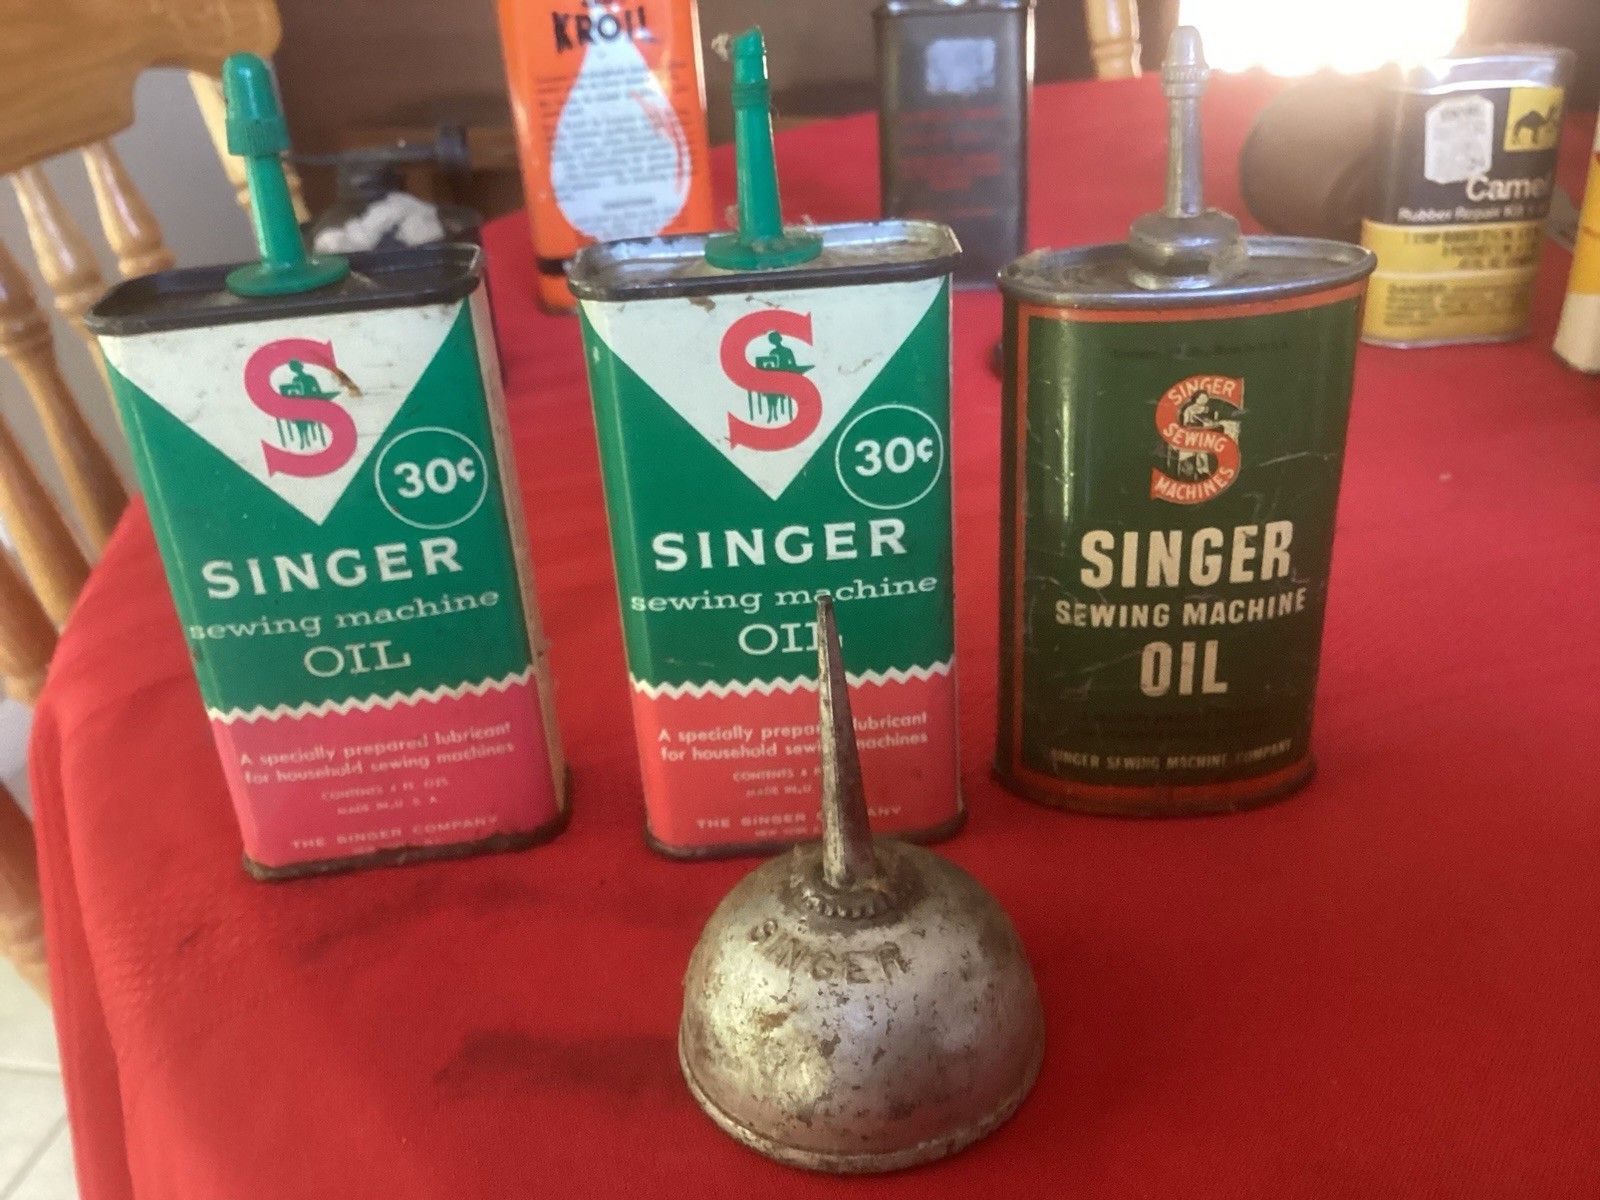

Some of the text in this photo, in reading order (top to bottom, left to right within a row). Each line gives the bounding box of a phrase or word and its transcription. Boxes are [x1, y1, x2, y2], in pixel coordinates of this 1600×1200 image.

[551, 5, 660, 55] KROIL
[1168, 376, 1236, 406] SINGER
[854, 435, 933, 477] 30¢
[1163, 423, 1225, 453] SEWING
[393, 456, 476, 499] 30¢
[1155, 466, 1234, 500] MACHINES
[652, 518, 908, 571] SINGER
[1080, 520, 1295, 589] SINGER
[202, 536, 463, 600] SINGER
[187, 590, 500, 640] sewing machine
[630, 590, 762, 614] sewing
[1055, 587, 1307, 628] SEWING MACHINE
[304, 639, 411, 678] OIL
[1140, 639, 1229, 697] OIL
[240, 720, 511, 767] A specially prepared lubricant
[658, 728, 671, 743] A
[678, 724, 753, 745] specially
[660, 746, 685, 762] for
[692, 742, 778, 761] household
[785, 740, 820, 756] sewi
[244, 743, 514, 785] for household sewing machines
[749, 918, 911, 985] SINGER
